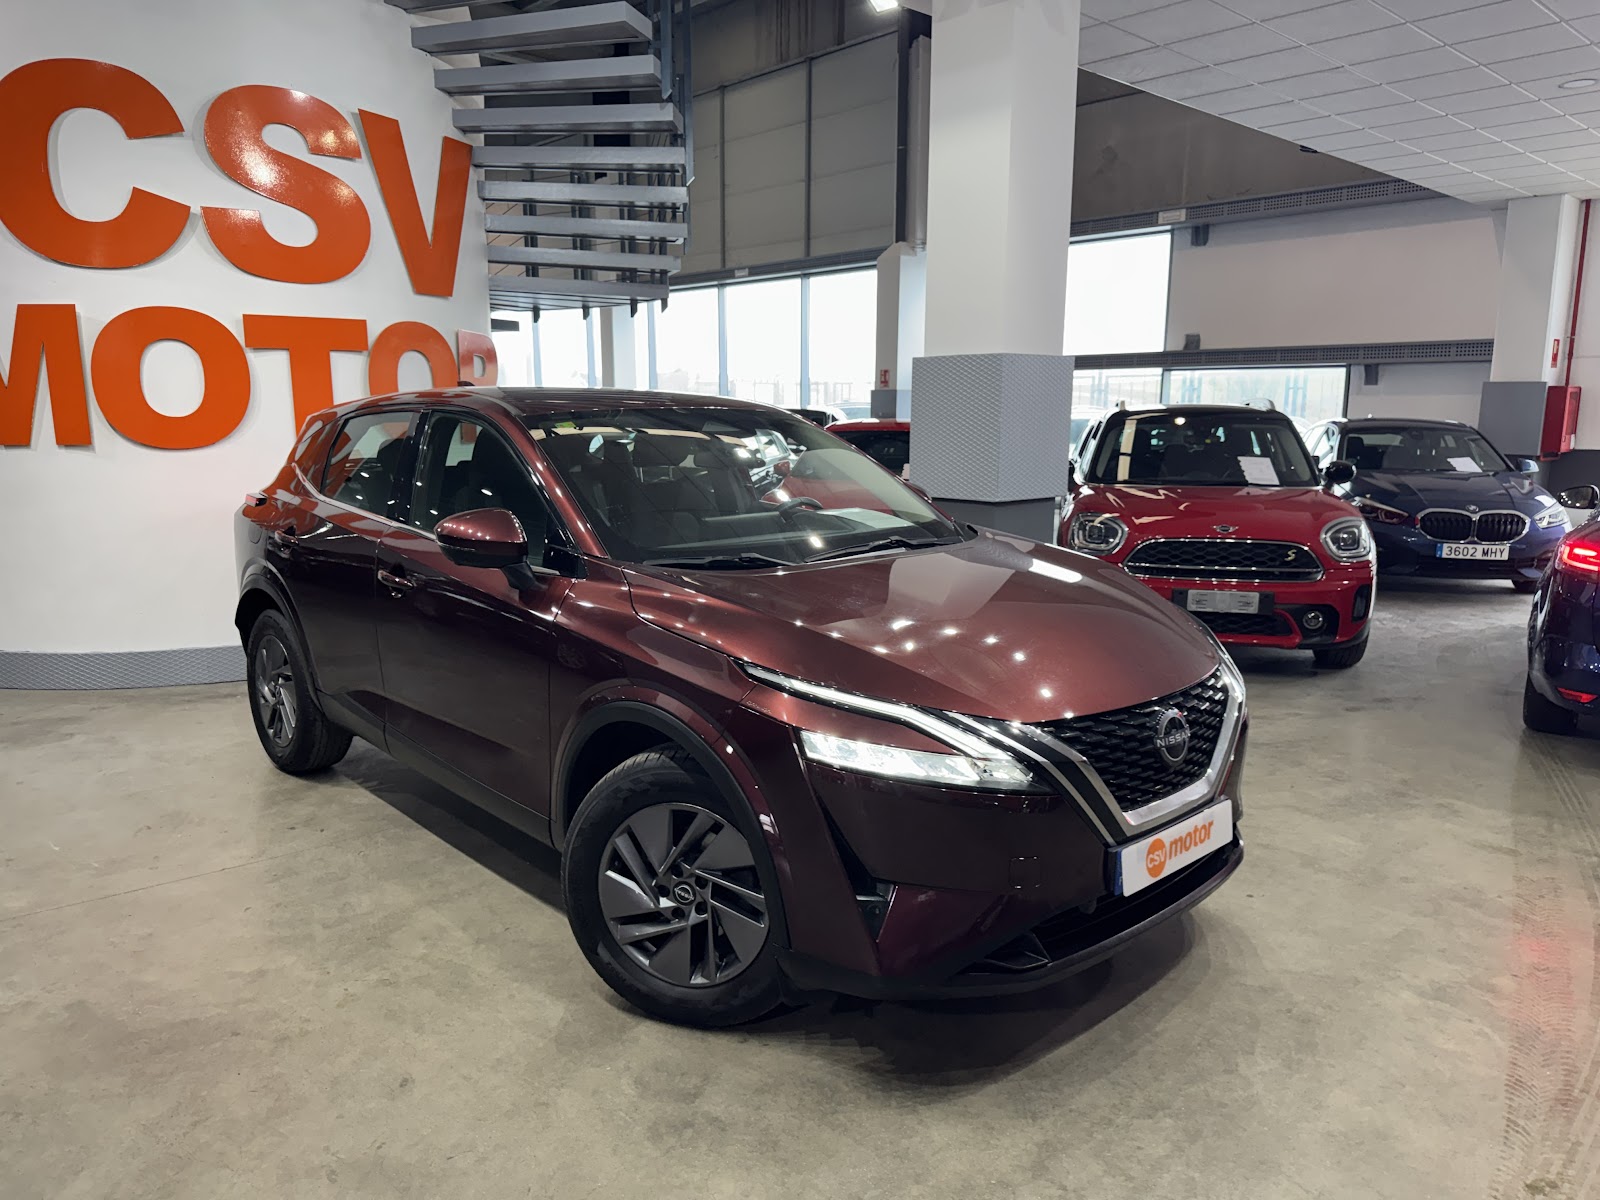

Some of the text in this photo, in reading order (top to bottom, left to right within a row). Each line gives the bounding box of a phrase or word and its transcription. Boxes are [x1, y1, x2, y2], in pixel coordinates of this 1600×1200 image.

[0, 57, 473, 298] CSV
[1445, 545, 1506, 558] 3602 MHY
[1156, 729, 1191, 748] NISSAN
[1168, 820, 1214, 860] motor
